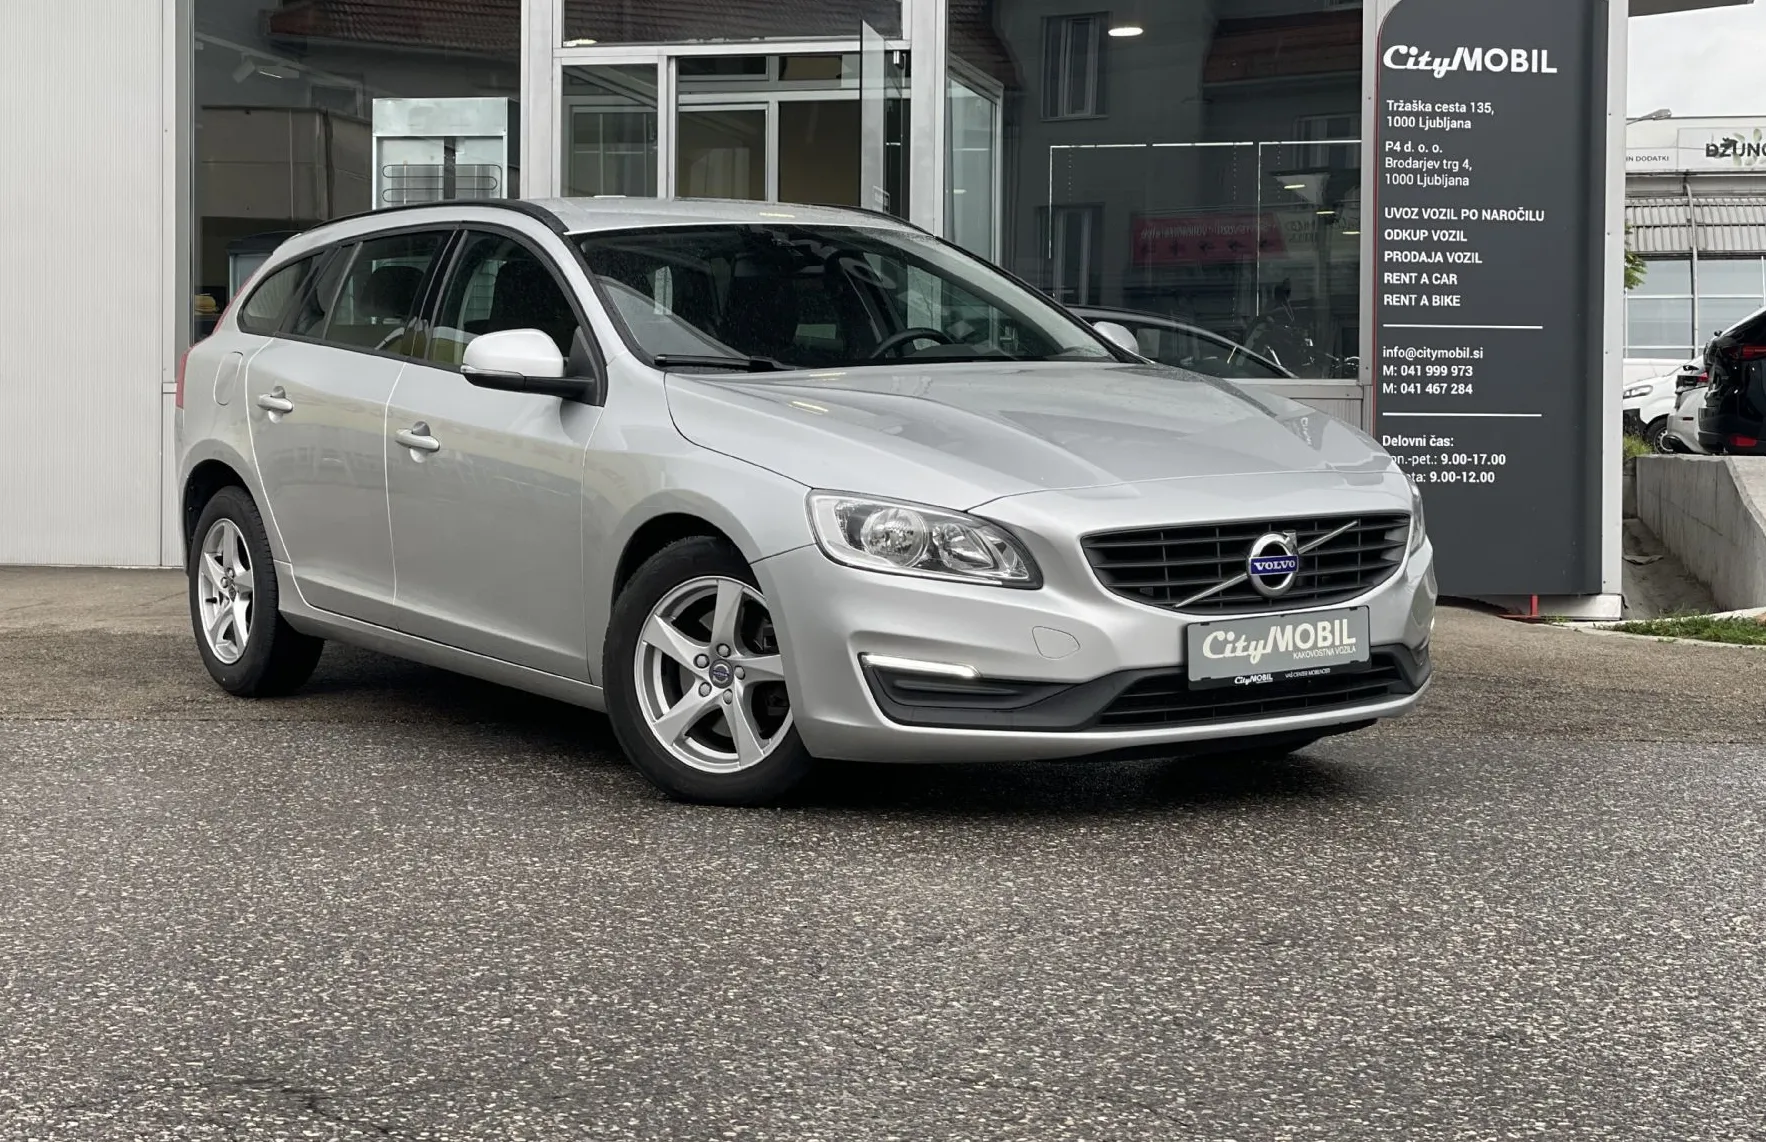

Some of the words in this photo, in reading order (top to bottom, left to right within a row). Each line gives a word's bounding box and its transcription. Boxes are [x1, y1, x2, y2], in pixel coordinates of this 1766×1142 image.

[1386, 99, 1433, 113] Tržaška
[1434, 102, 1467, 114] cesta
[1469, 101, 1495, 116] 135,
[1386, 115, 1416, 129] 1000
[1418, 115, 1472, 132] Ljubljana
[1385, 140, 1402, 153] P4
[1403, 141, 1415, 154] d.
[1417, 143, 1429, 154] o.
[1431, 143, 1443, 154] o.
[1385, 157, 1441, 172] Brodarjev
[1442, 158, 1460, 173] trg
[1461, 158, 1473, 172] 4,
[1635, 155, 1670, 163] DODATKI
[1385, 172, 1414, 186] 1000
[1416, 173, 1470, 189] Ljubljana
[1384, 207, 1419, 219] UVOZ
[1421, 208, 1459, 220] VOZIL
[1460, 208, 1479, 220] PO
[1481, 207, 1545, 222] NAROČILU
[1384, 229, 1429, 241] ODKUP
[1431, 229, 1468, 242] VOZIL
[1384, 250, 1444, 263] PRODAJA
[1446, 251, 1483, 264] VOZIL
[1384, 272, 1418, 285] RENT
[1420, 273, 1430, 285] A
[1431, 273, 1458, 285] CAR
[1383, 294, 1418, 306] RENT
[1420, 294, 1430, 306] A
[1431, 295, 1461, 307] BIKE
[1382, 345, 1484, 362] info@citymobil.si
[1382, 364, 1398, 377] M:
[1400, 364, 1422, 377] 041
[1425, 364, 1448, 377] 999
[1450, 364, 1474, 377] 973
[1382, 382, 1398, 395] M:
[1400, 382, 1421, 395] 041
[1424, 382, 1448, 395] 467
[1450, 382, 1474, 395] 284
[1382, 434, 1427, 447] Delovni
[1429, 434, 1454, 447] čas:
[1440, 453, 1507, 466] 9.00-17.00
[1429, 471, 1496, 484] 9.00-12.00
[1253, 559, 1296, 571] VOLVO
[1293, 649, 1335, 660] KAKOVOSTNA
[1335, 645, 1357, 655] VOZILA
